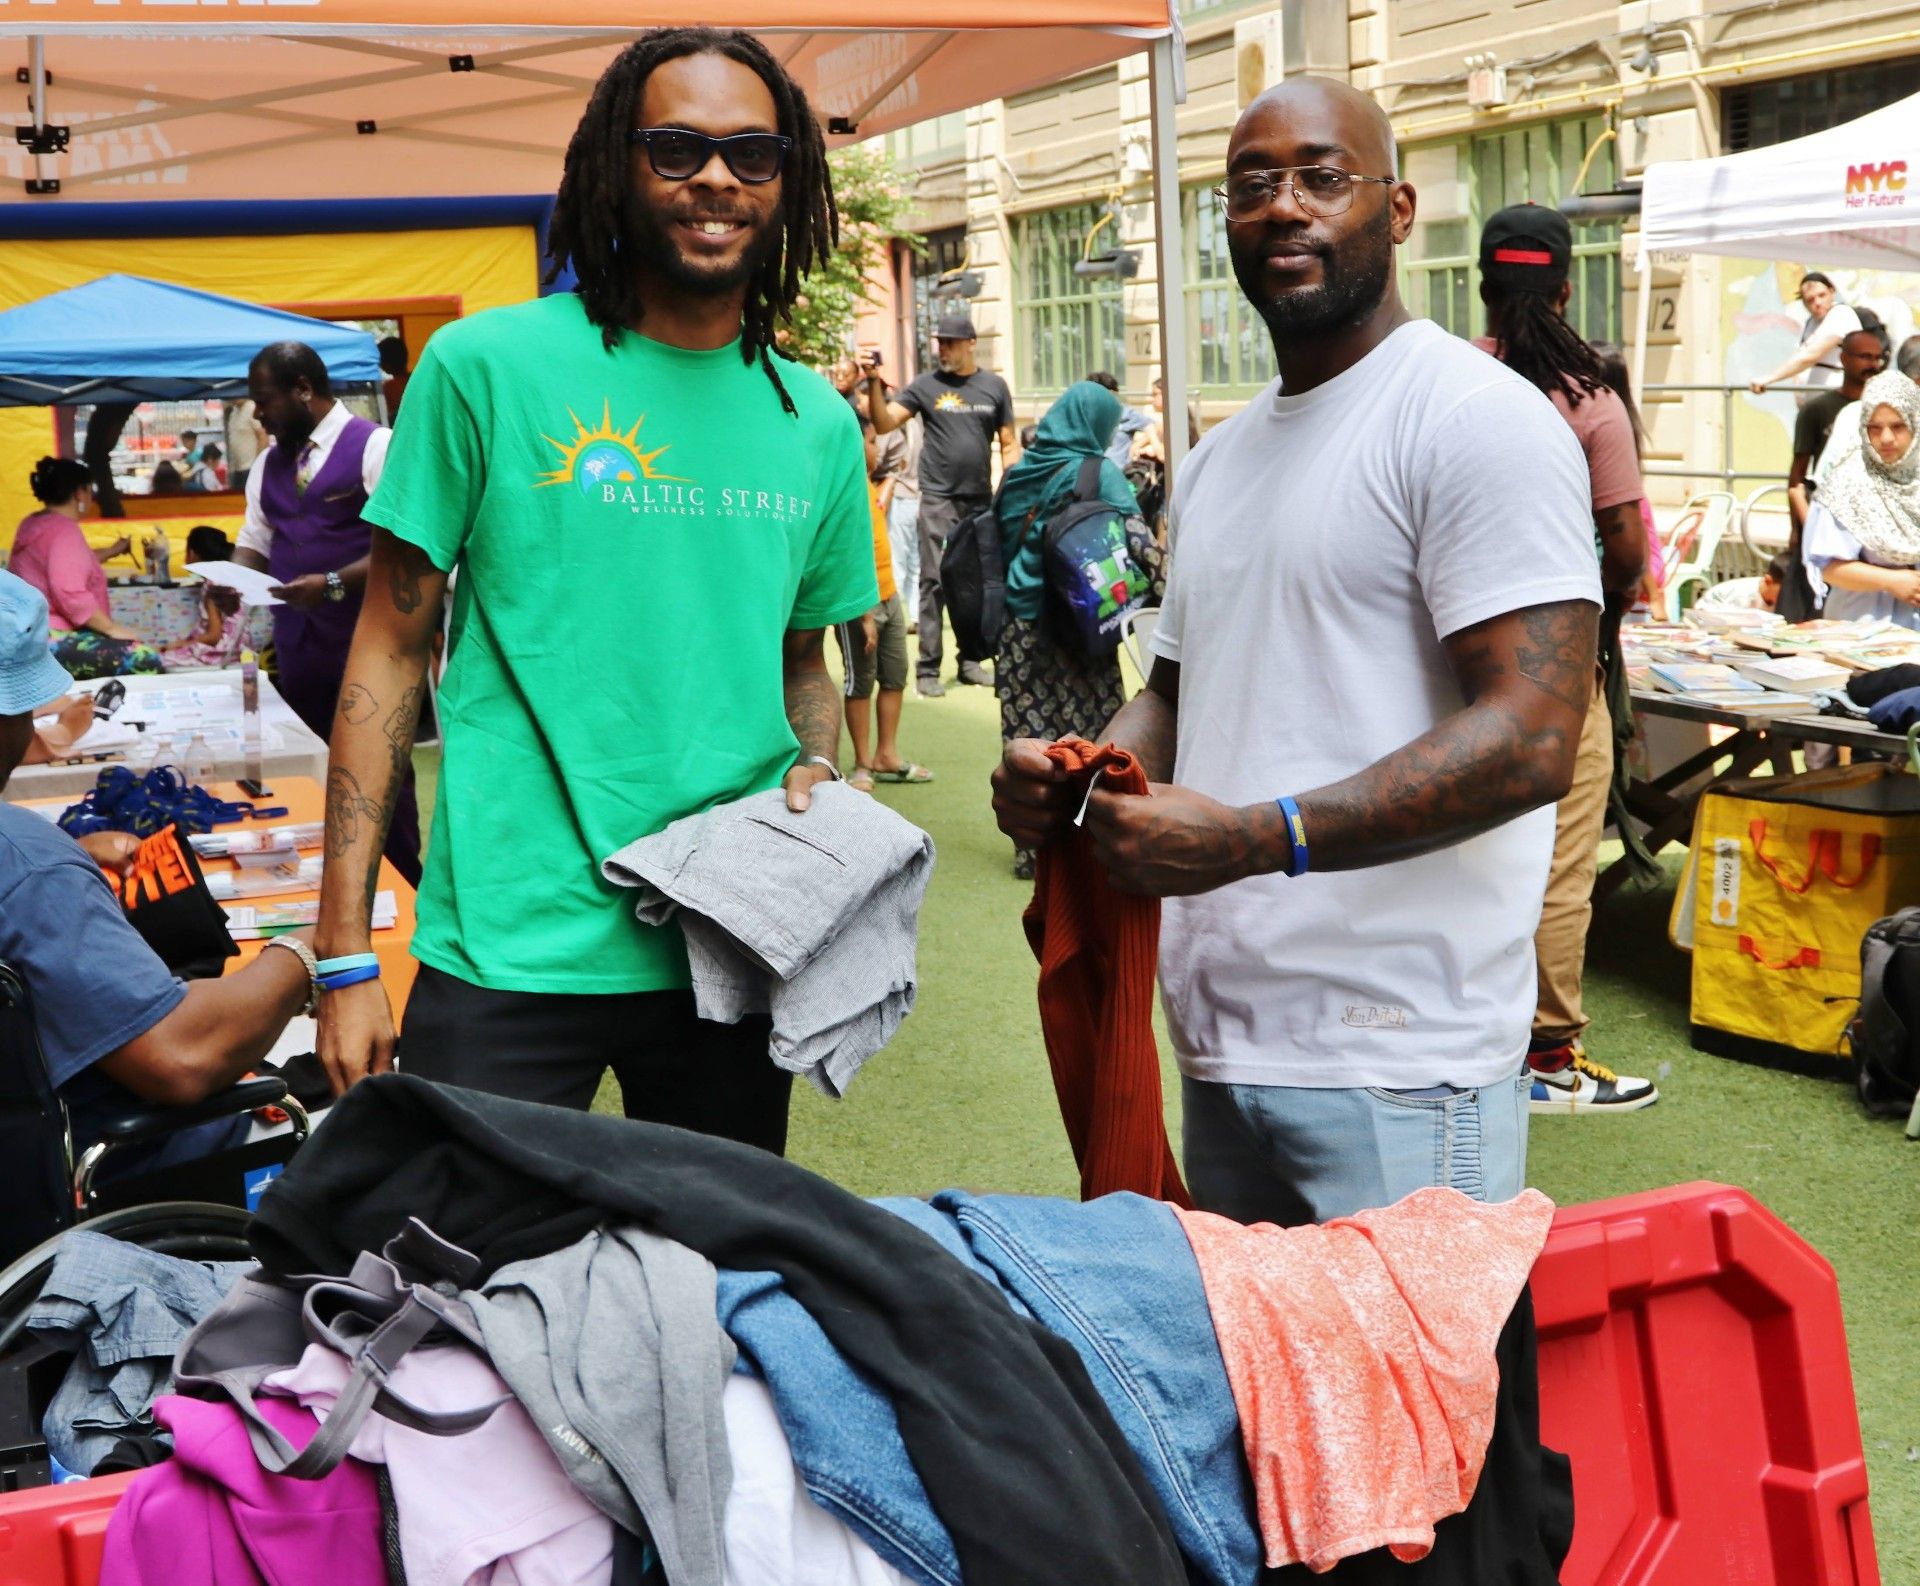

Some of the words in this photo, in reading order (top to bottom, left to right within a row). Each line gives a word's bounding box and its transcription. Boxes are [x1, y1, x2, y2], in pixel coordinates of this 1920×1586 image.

[1846, 161, 1908, 194] NYC
[1846, 196, 1866, 208] Her
[1868, 194, 1905, 207] Future
[602, 483, 705, 506] BALTIC
[721, 488, 811, 519] STREET
[631, 505, 705, 516] WELLNESS
[716, 507, 793, 523] SOLUTIONS
